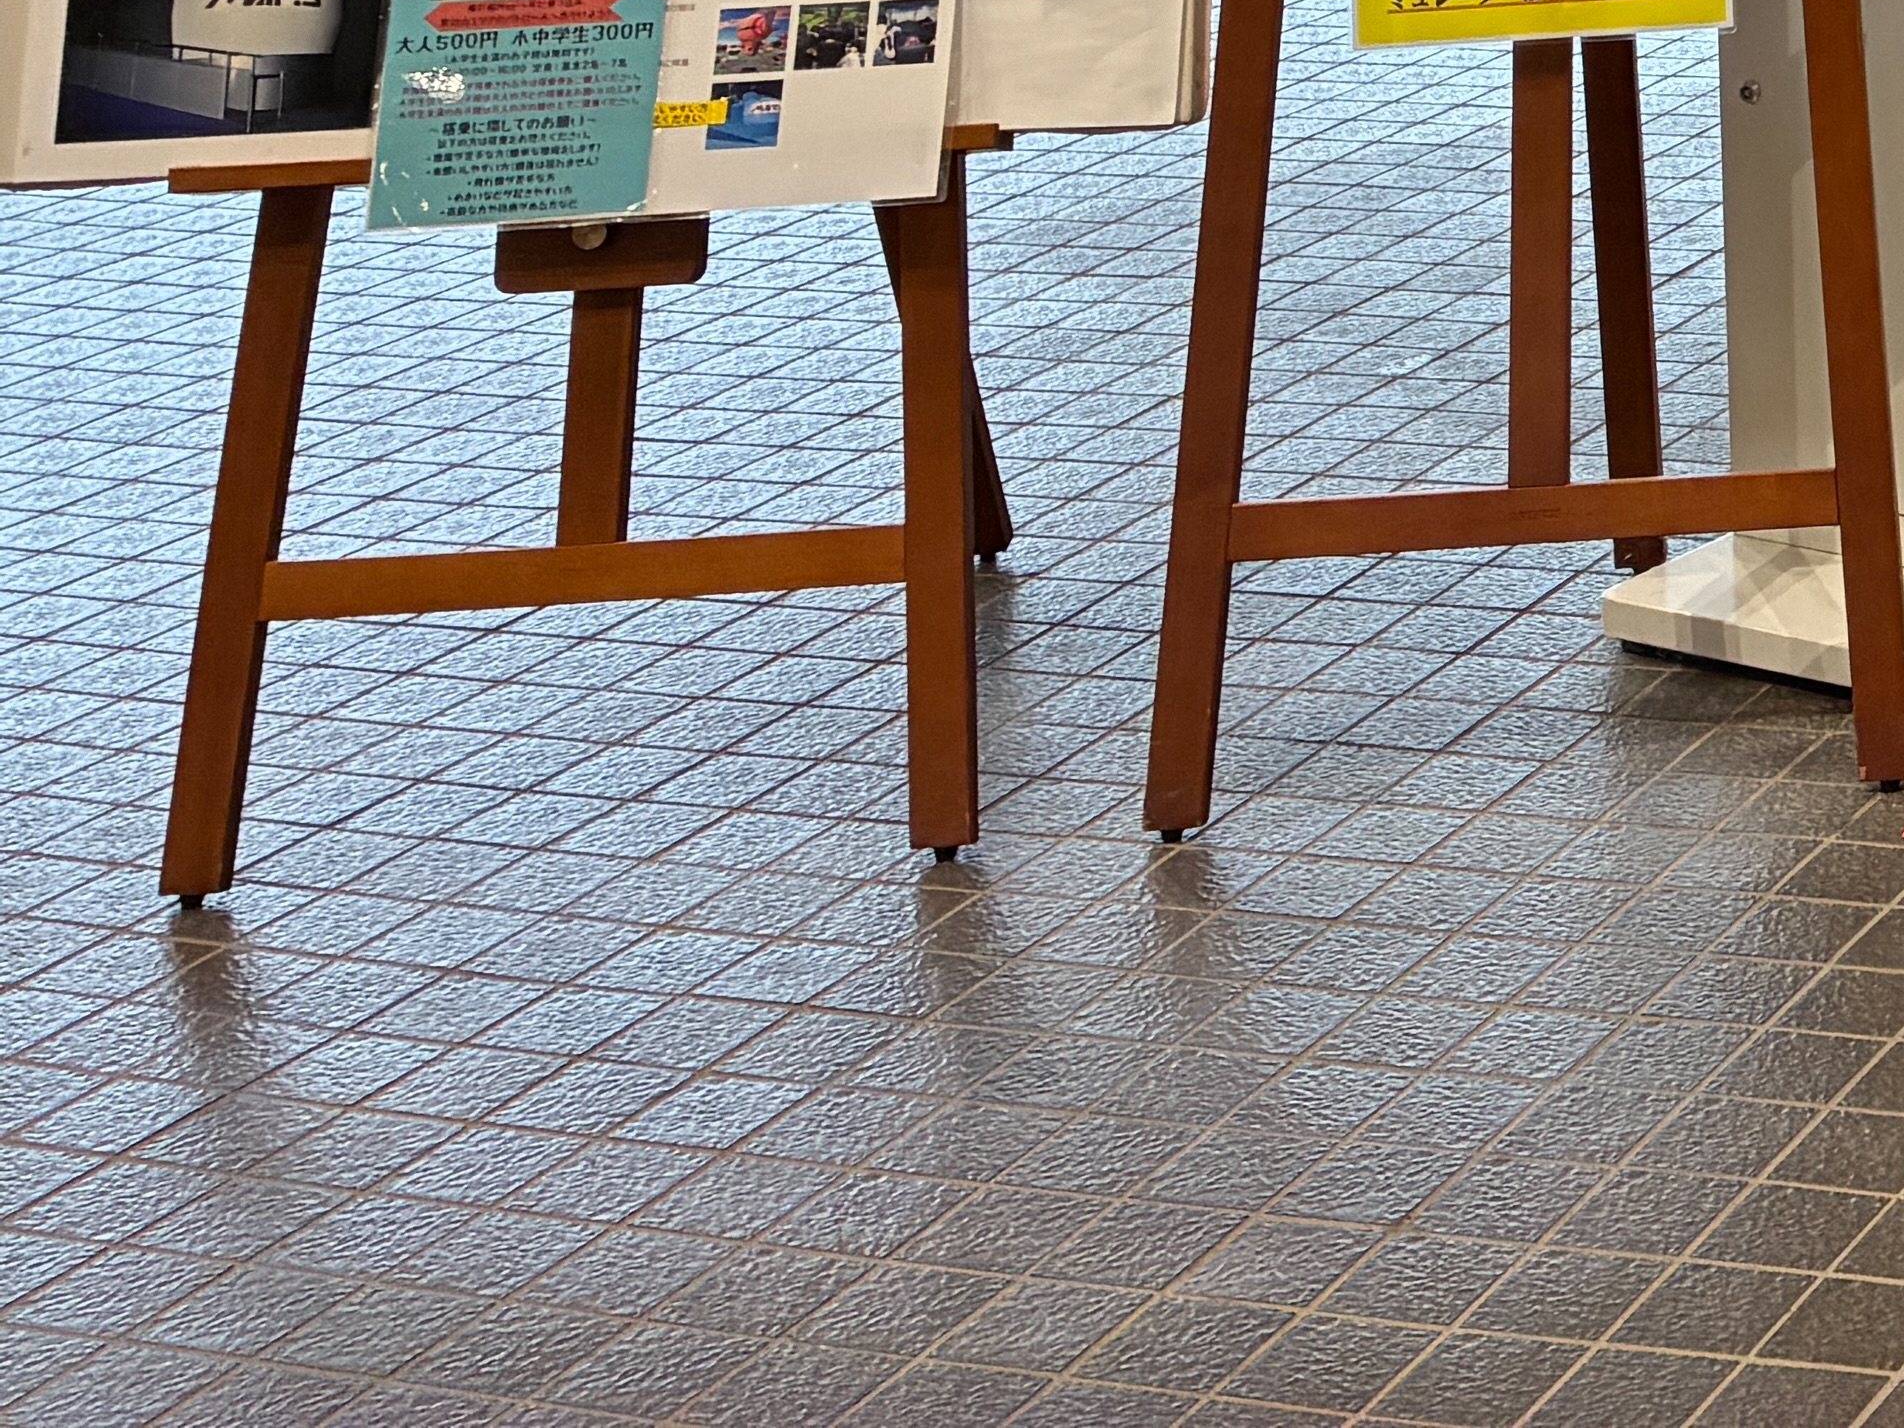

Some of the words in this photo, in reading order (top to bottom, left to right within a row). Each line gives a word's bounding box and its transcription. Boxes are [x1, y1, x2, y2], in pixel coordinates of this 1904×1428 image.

[399, 31, 498, 54] 大人500円
[511, 22, 653, 46] 小中学生300円
